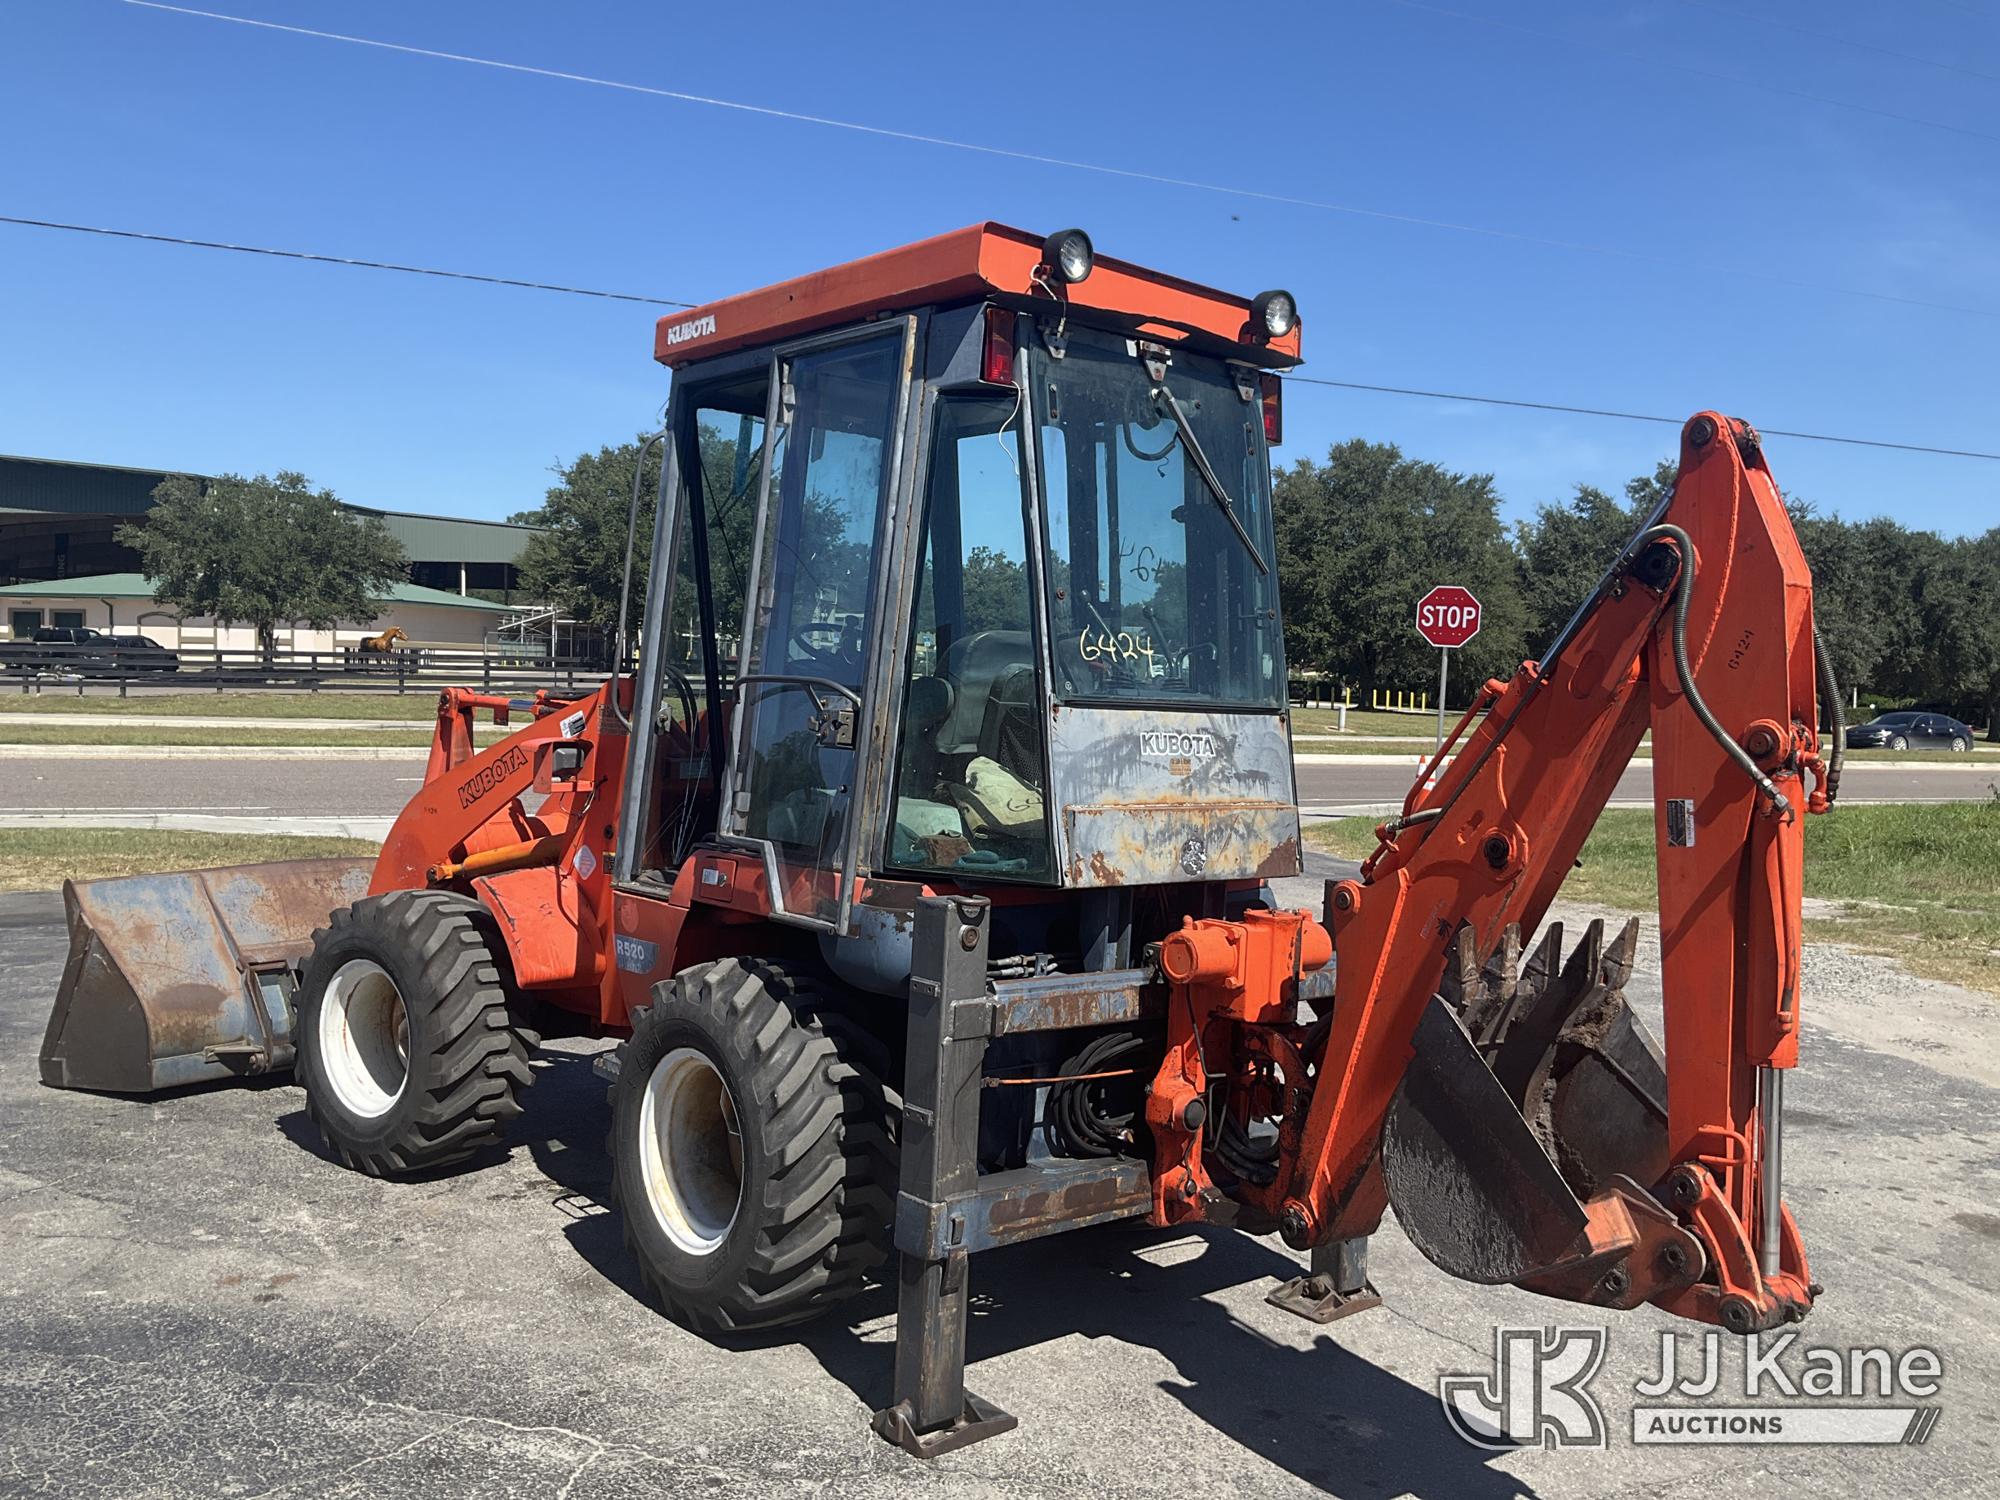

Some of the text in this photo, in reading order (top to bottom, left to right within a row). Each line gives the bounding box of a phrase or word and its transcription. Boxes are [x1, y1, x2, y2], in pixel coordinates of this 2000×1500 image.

[667, 314, 716, 345] KUBOTA
[1421, 605, 1476, 629] STOP
[1080, 624, 1154, 678] 6424
[1140, 732, 1216, 757] KUBOTA
[457, 745, 528, 809] KUBOTA
[616, 940, 645, 960] R520
